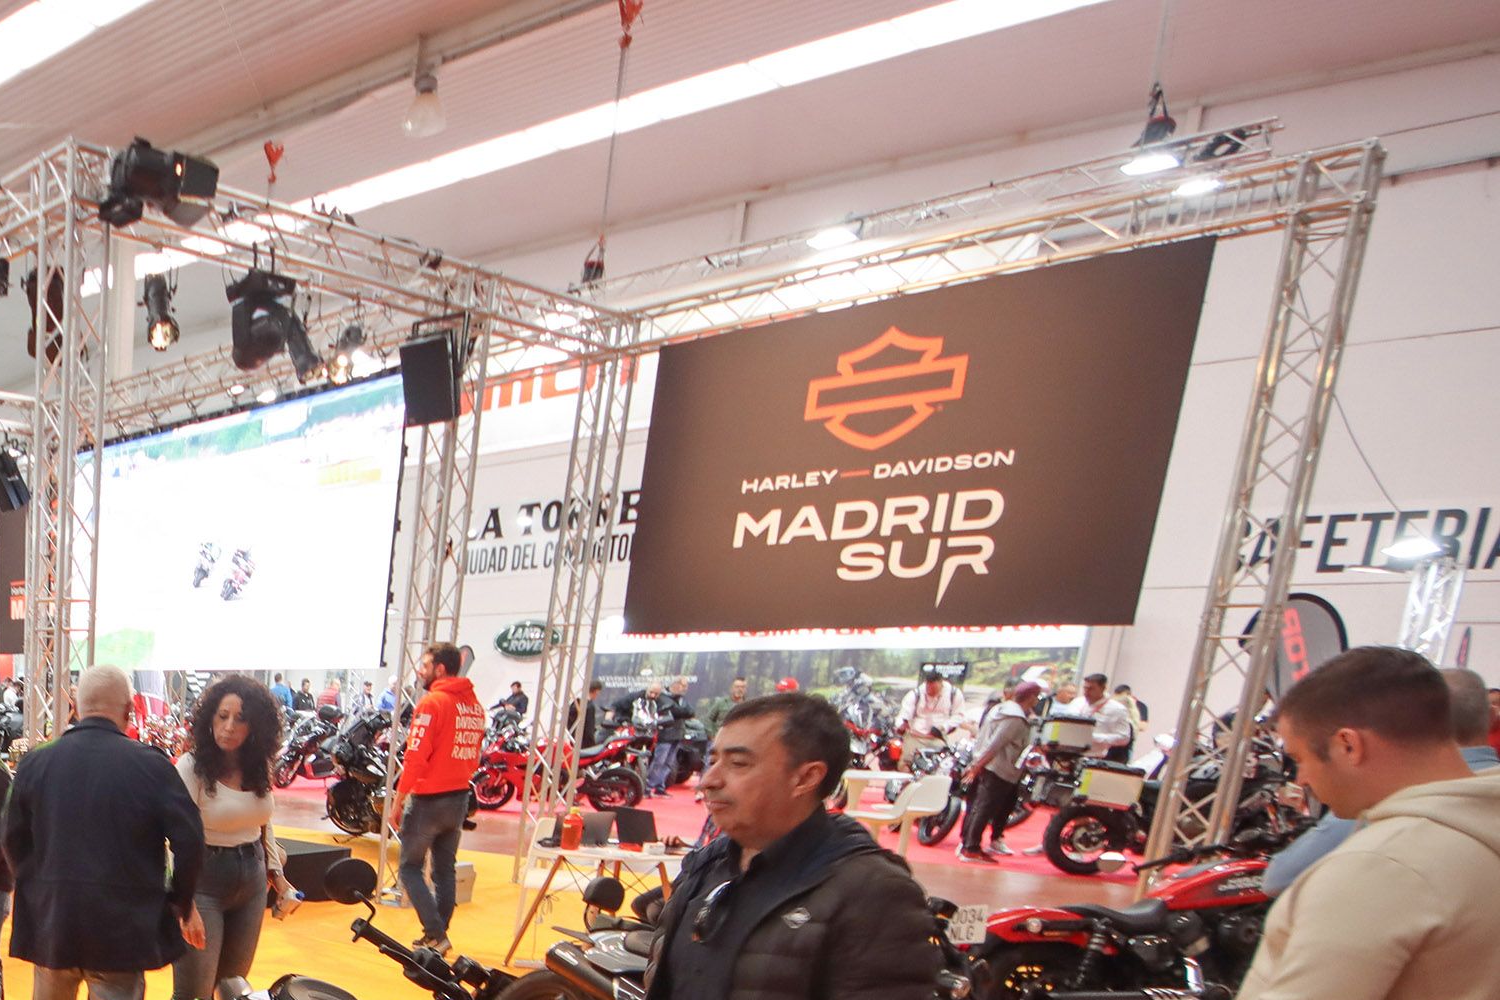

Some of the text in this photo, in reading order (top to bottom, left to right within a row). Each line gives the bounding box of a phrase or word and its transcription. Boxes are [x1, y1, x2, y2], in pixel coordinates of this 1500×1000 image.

[741, 449, 1015, 494] HARLEY DAVIDSON
[732, 489, 1005, 548] MADRID
[1237, 507, 1500, 573] AFETERI
[511, 543, 538, 571] DEL
[836, 535, 995, 608] SUR
[508, 639, 546, 652] ROVE
